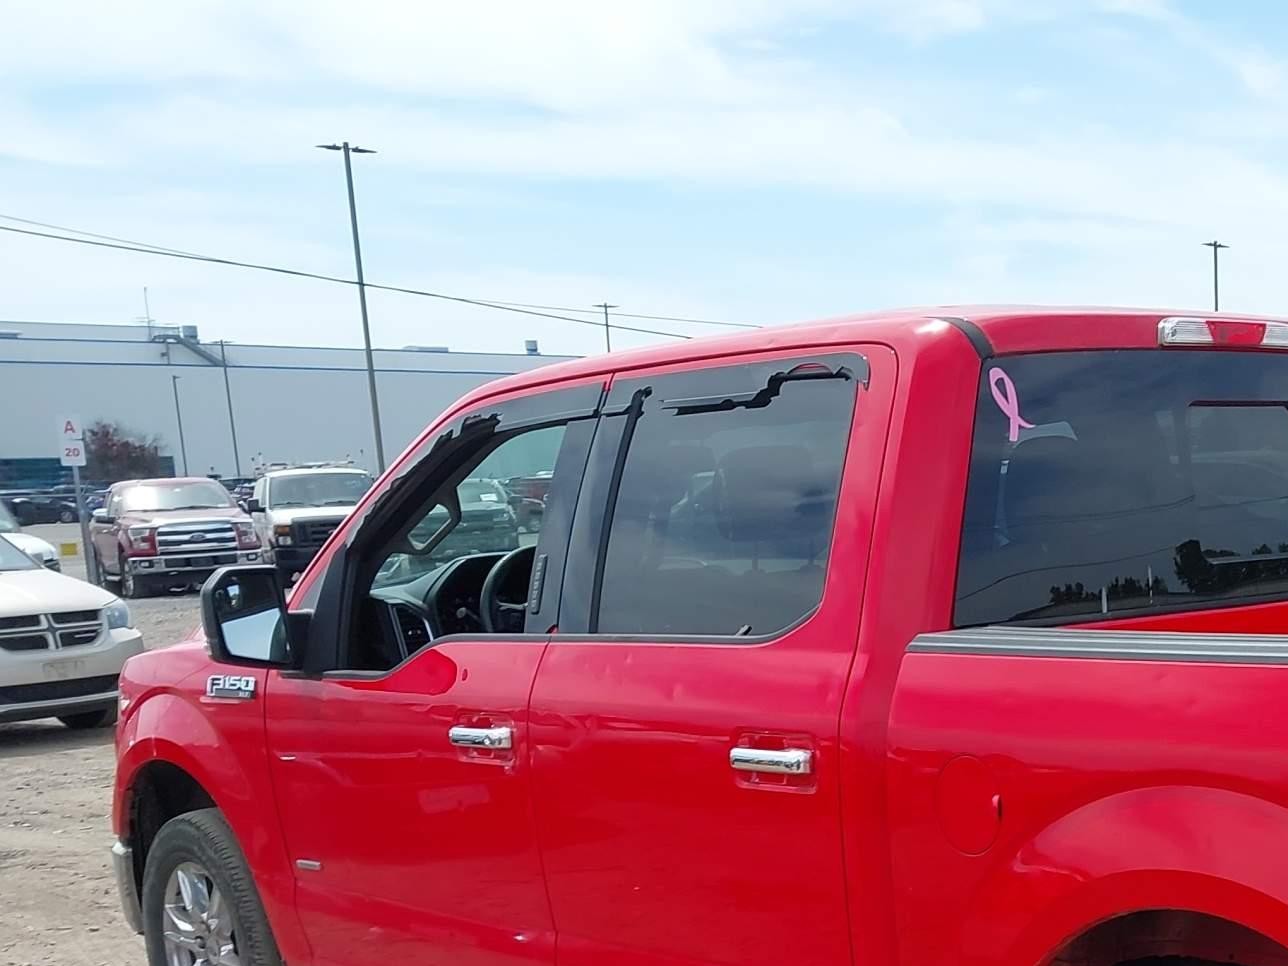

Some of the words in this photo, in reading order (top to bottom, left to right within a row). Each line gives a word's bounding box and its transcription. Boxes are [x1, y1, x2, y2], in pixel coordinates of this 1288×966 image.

[64, 420, 76, 434] A
[65, 448, 80, 457] 20
[206, 674, 256, 697] F150
